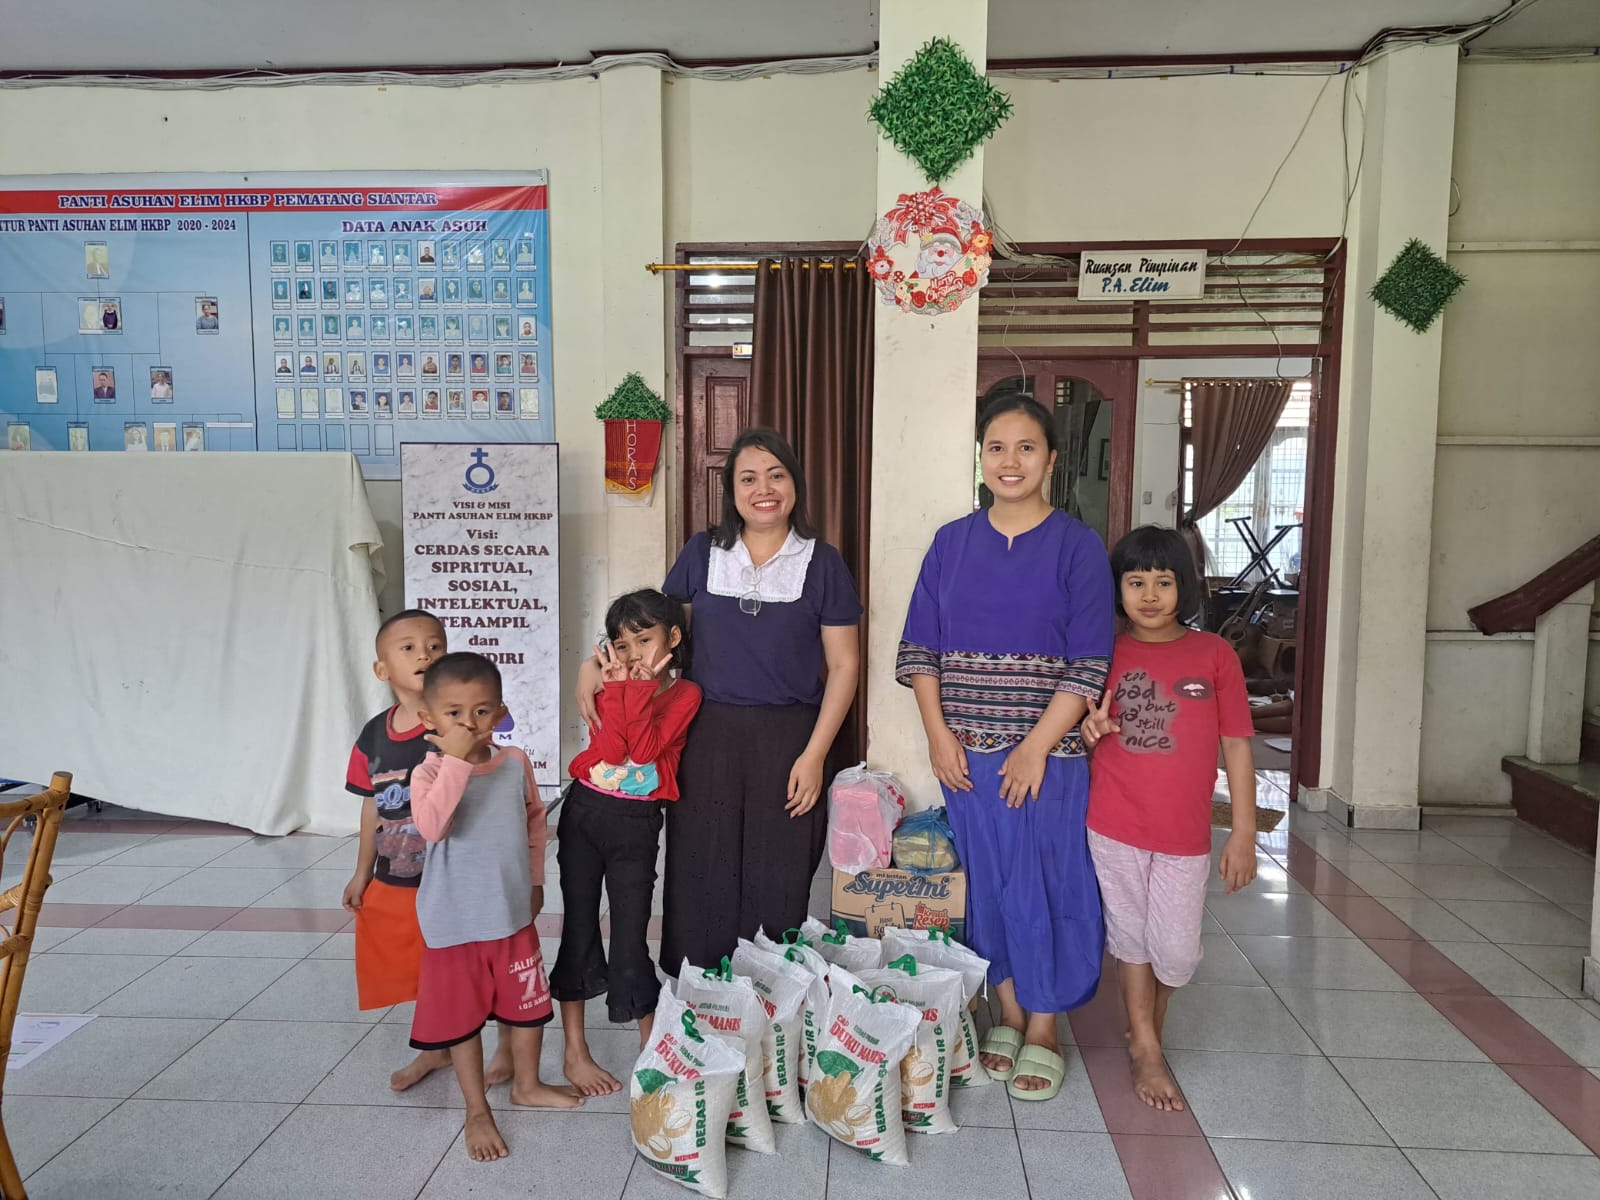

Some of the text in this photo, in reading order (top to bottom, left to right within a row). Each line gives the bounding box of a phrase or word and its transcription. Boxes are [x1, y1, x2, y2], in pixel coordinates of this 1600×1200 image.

[59, 193, 438, 208] PANTI ASUHAN ELIM HKBP PEMATANG SIANTAR
[28, 219, 59, 231] PANTI
[62, 219, 106, 231] ASUHAN
[110, 219, 138, 231] ELIM
[141, 219, 171, 231] HKBP
[177, 219, 202, 231] 2020
[211, 219, 236, 231] 2024
[342, 221, 487, 232] DATA ANAK ASUH
[1139, 258, 1199, 276] Pimpinan
[625, 420, 638, 490] HORAS
[413, 512, 445, 520] PANTI
[448, 512, 493, 520] ASUHAN
[466, 529, 499, 539] Visi:
[414, 545, 550, 556] CERDAS SECARA
[431, 562, 533, 576] SIPRITUAL,
[448, 580, 518, 594] SOSIAL,
[417, 598, 548, 612] INTELEKTUAL,
[439, 616, 530, 628] TERAMPIL
[468, 635, 500, 646] dan
[1122, 672, 1147, 682] too
[1114, 680, 1156, 701] bad
[1145, 699, 1176, 713] but
[1135, 718, 1165, 731] still
[1125, 729, 1172, 749] nice
[804, 1010, 814, 1027] 64
[775, 1034, 785, 1047] IR
[805, 1029, 815, 1042] IR
[936, 1039, 946, 1052] IR
[776, 1049, 787, 1087] BERAS
[935, 1056, 946, 1098] BERAS
[694, 1080, 705, 1096] IR
[874, 1094, 887, 1134] BERAS
[695, 1099, 707, 1148] BERAS
